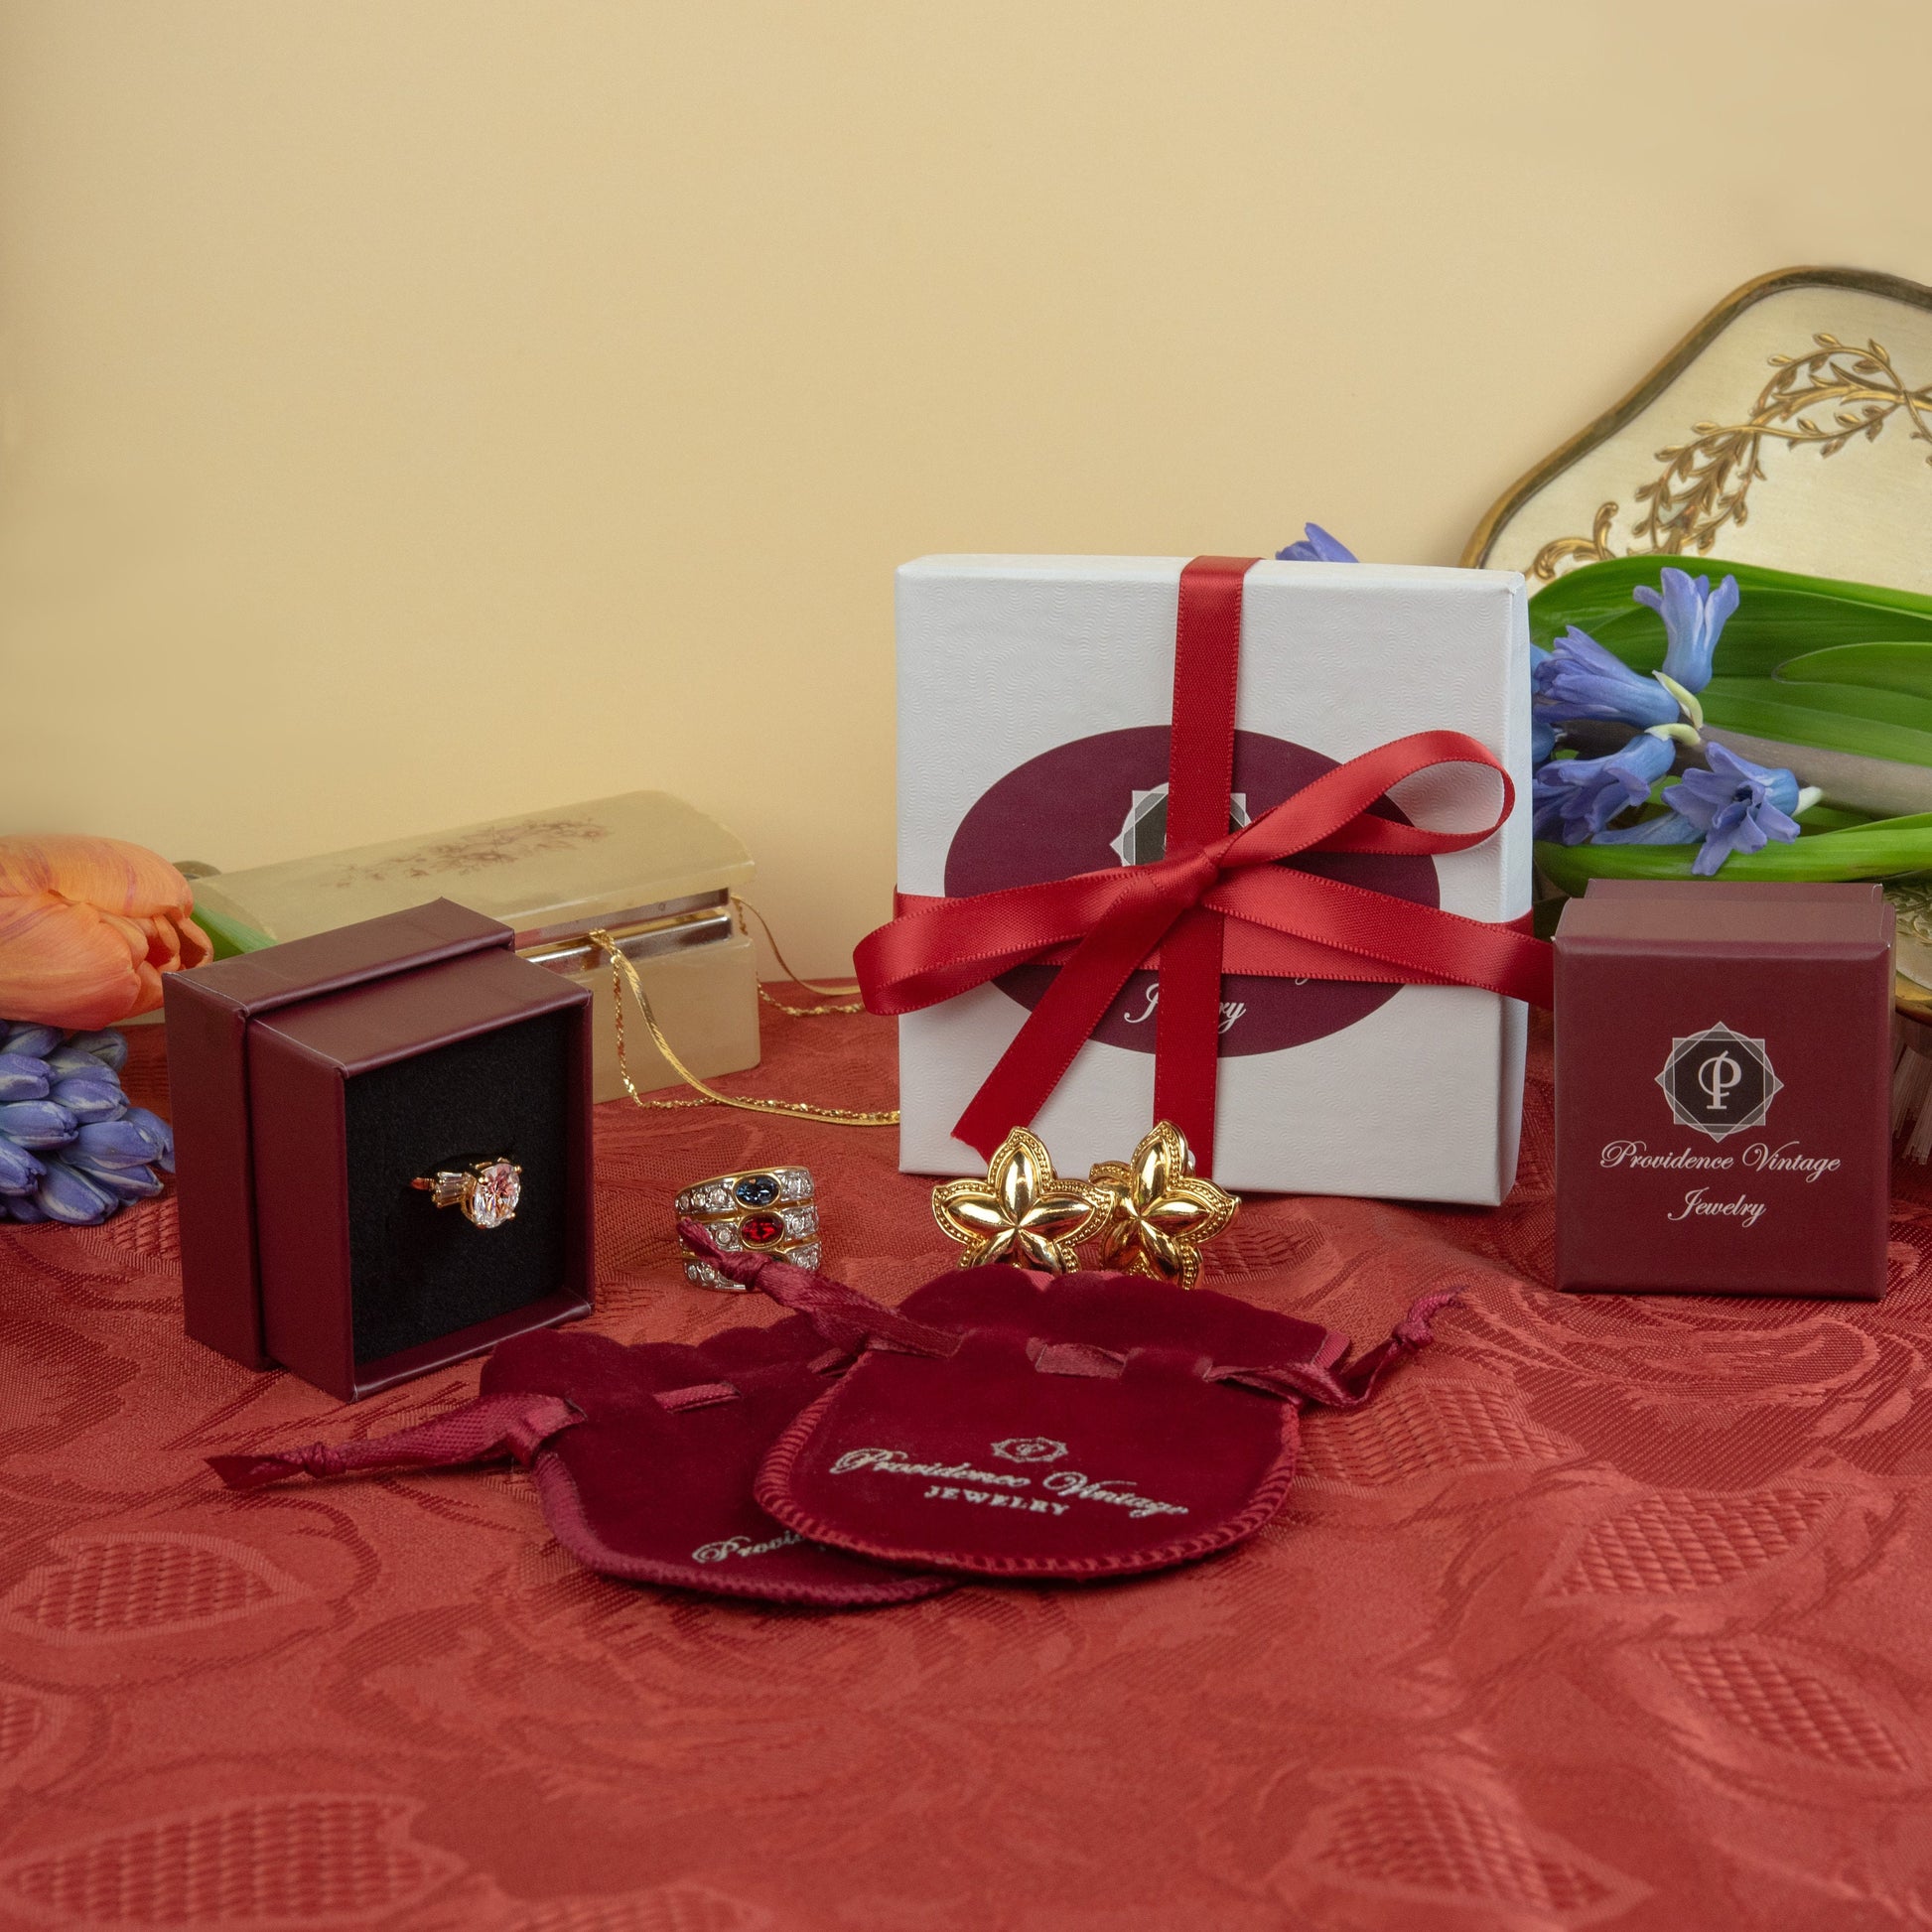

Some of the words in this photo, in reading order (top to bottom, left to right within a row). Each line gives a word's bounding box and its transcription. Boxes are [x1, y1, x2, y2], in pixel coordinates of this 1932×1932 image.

[1599, 1140, 1734, 1170] Providence
[1741, 1141, 1842, 1183] Vintage
[1667, 1186, 1767, 1228] Jewelry
[829, 1448, 1032, 1487] Providence
[1042, 1471, 1189, 1518] Vintage
[924, 1485, 1070, 1516] JEWELRY
